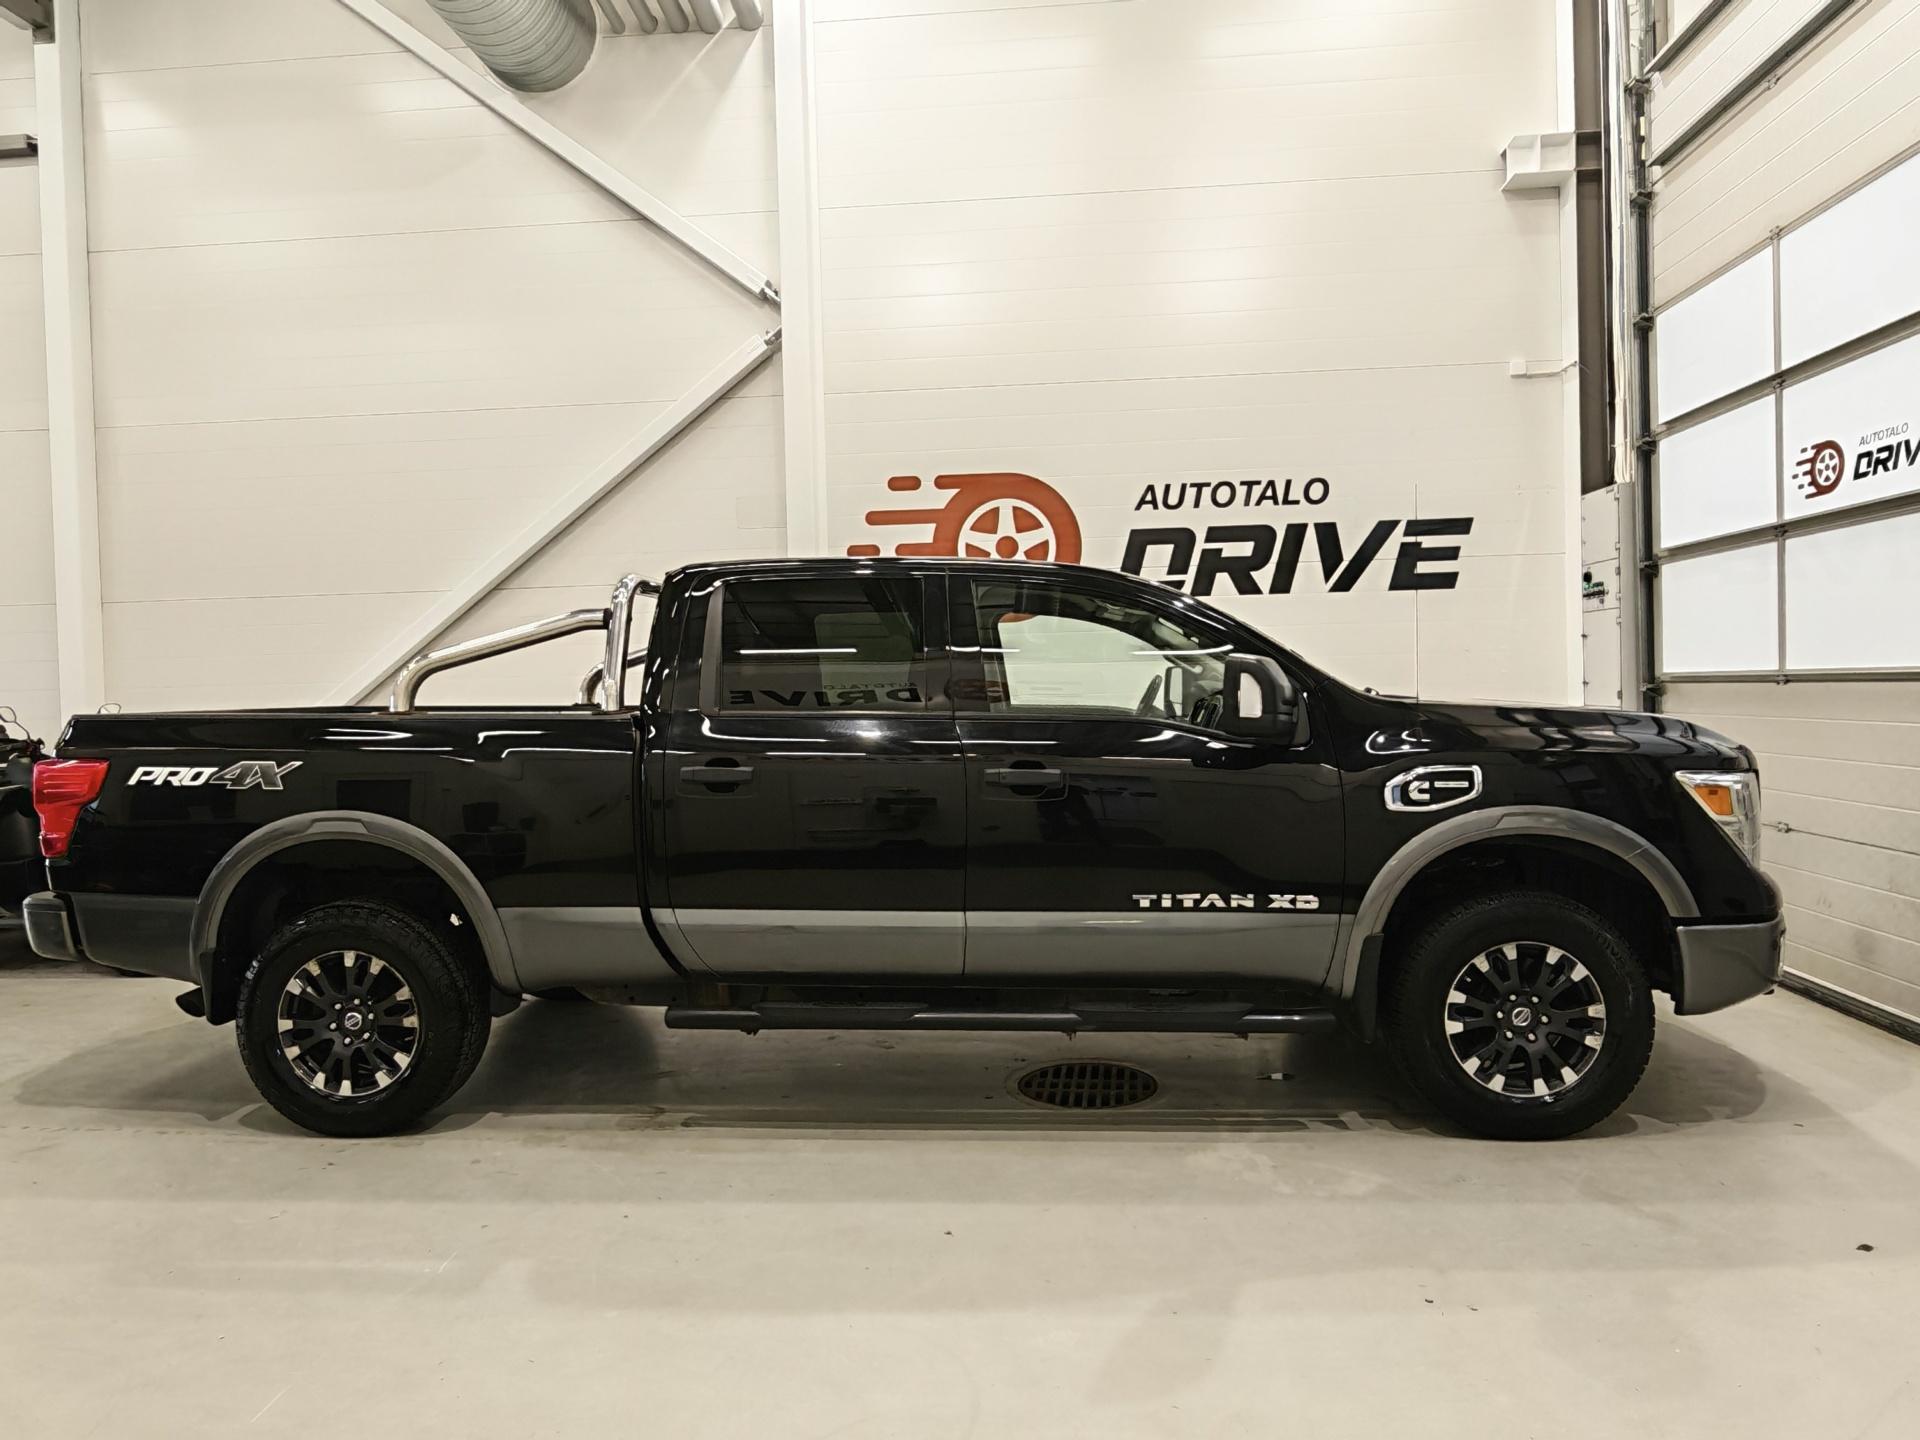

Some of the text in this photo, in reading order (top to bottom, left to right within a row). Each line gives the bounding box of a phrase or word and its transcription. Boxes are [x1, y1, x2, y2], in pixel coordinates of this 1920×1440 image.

[1859, 422, 1909, 447] AUTOTALO
[1135, 477, 1330, 511] AUTOTALO
[1120, 517, 1475, 597] DRIVE
[1132, 893, 1320, 909] TITAN XD
